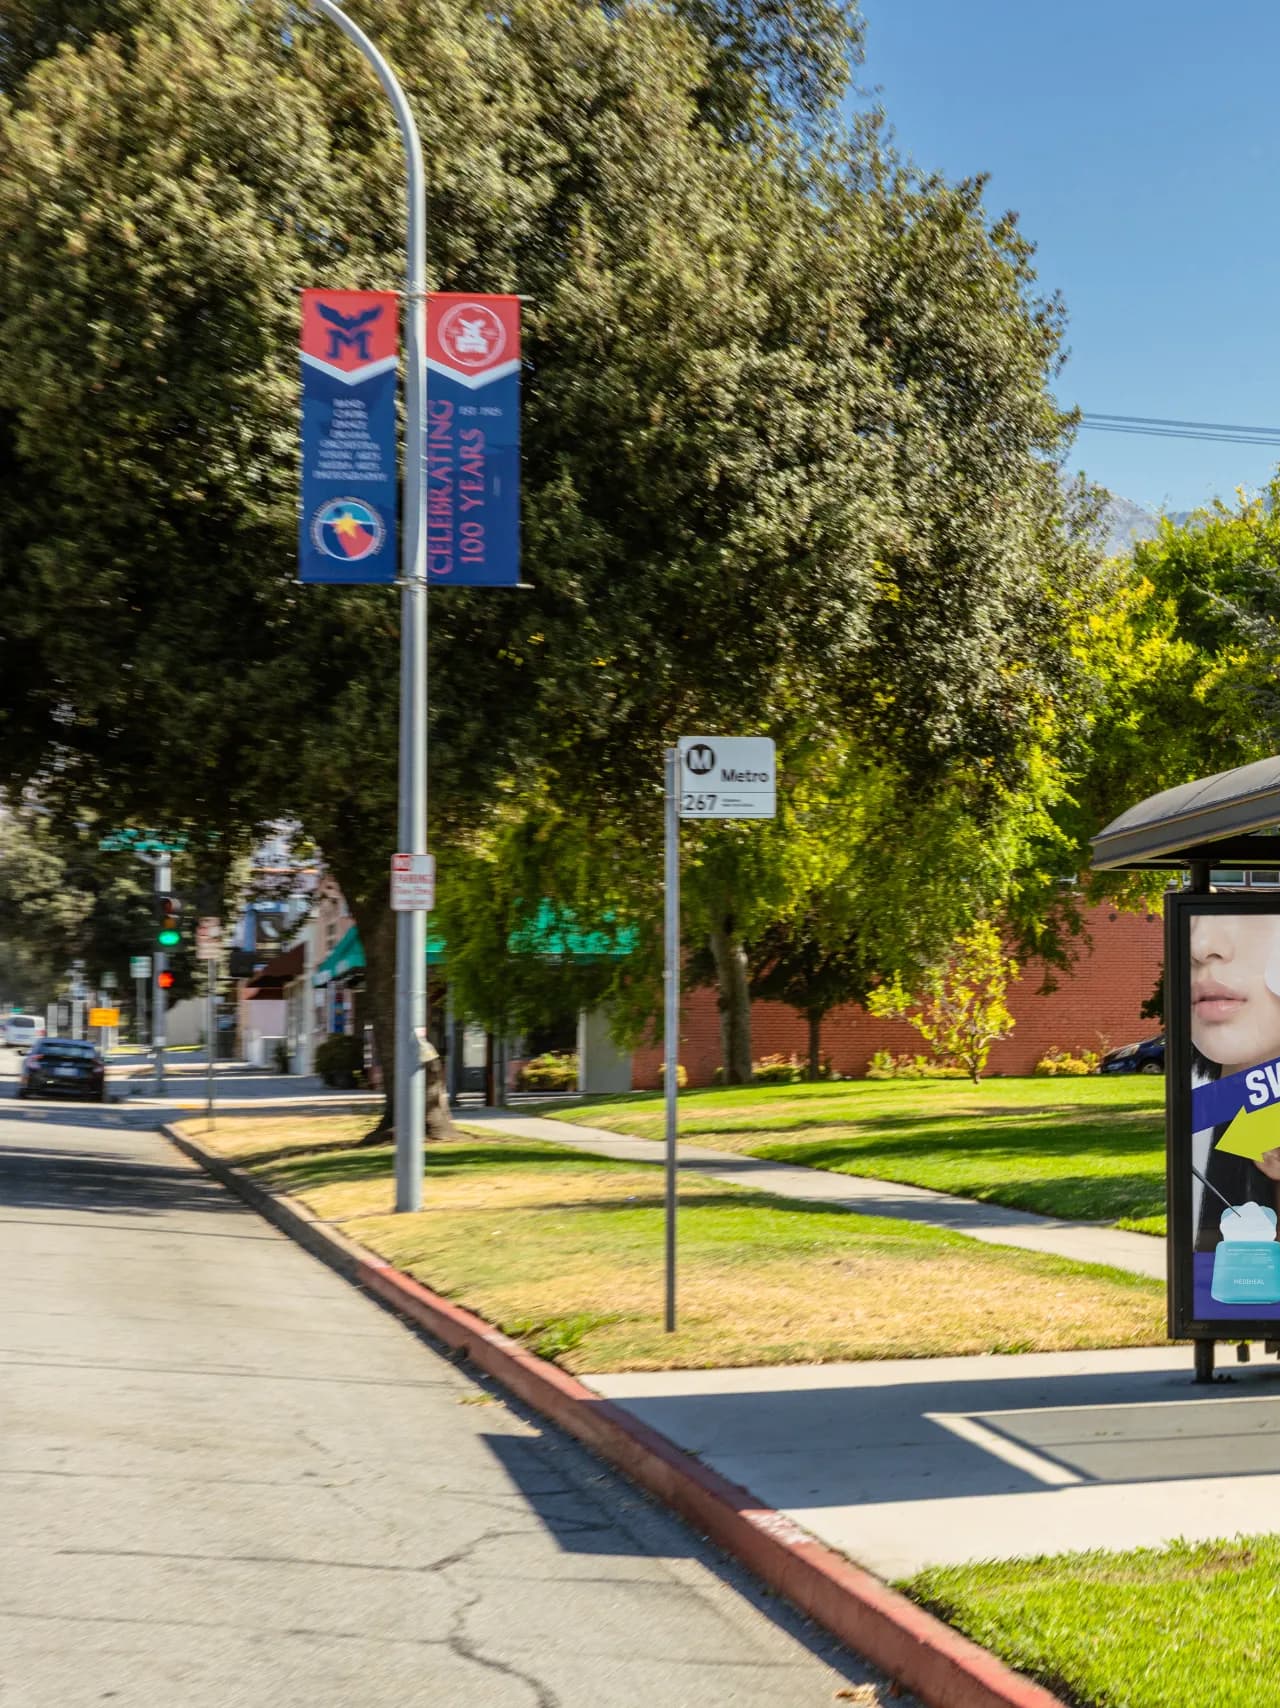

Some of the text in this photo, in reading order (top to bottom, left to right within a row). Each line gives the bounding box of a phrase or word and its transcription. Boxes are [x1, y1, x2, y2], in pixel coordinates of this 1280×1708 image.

[428, 400, 453, 575] CELEBRATING
[459, 428, 485, 512] YEARS
[459, 521, 485, 563] 100
[721, 769, 769, 782] Metro
[685, 795, 717, 810] 267
